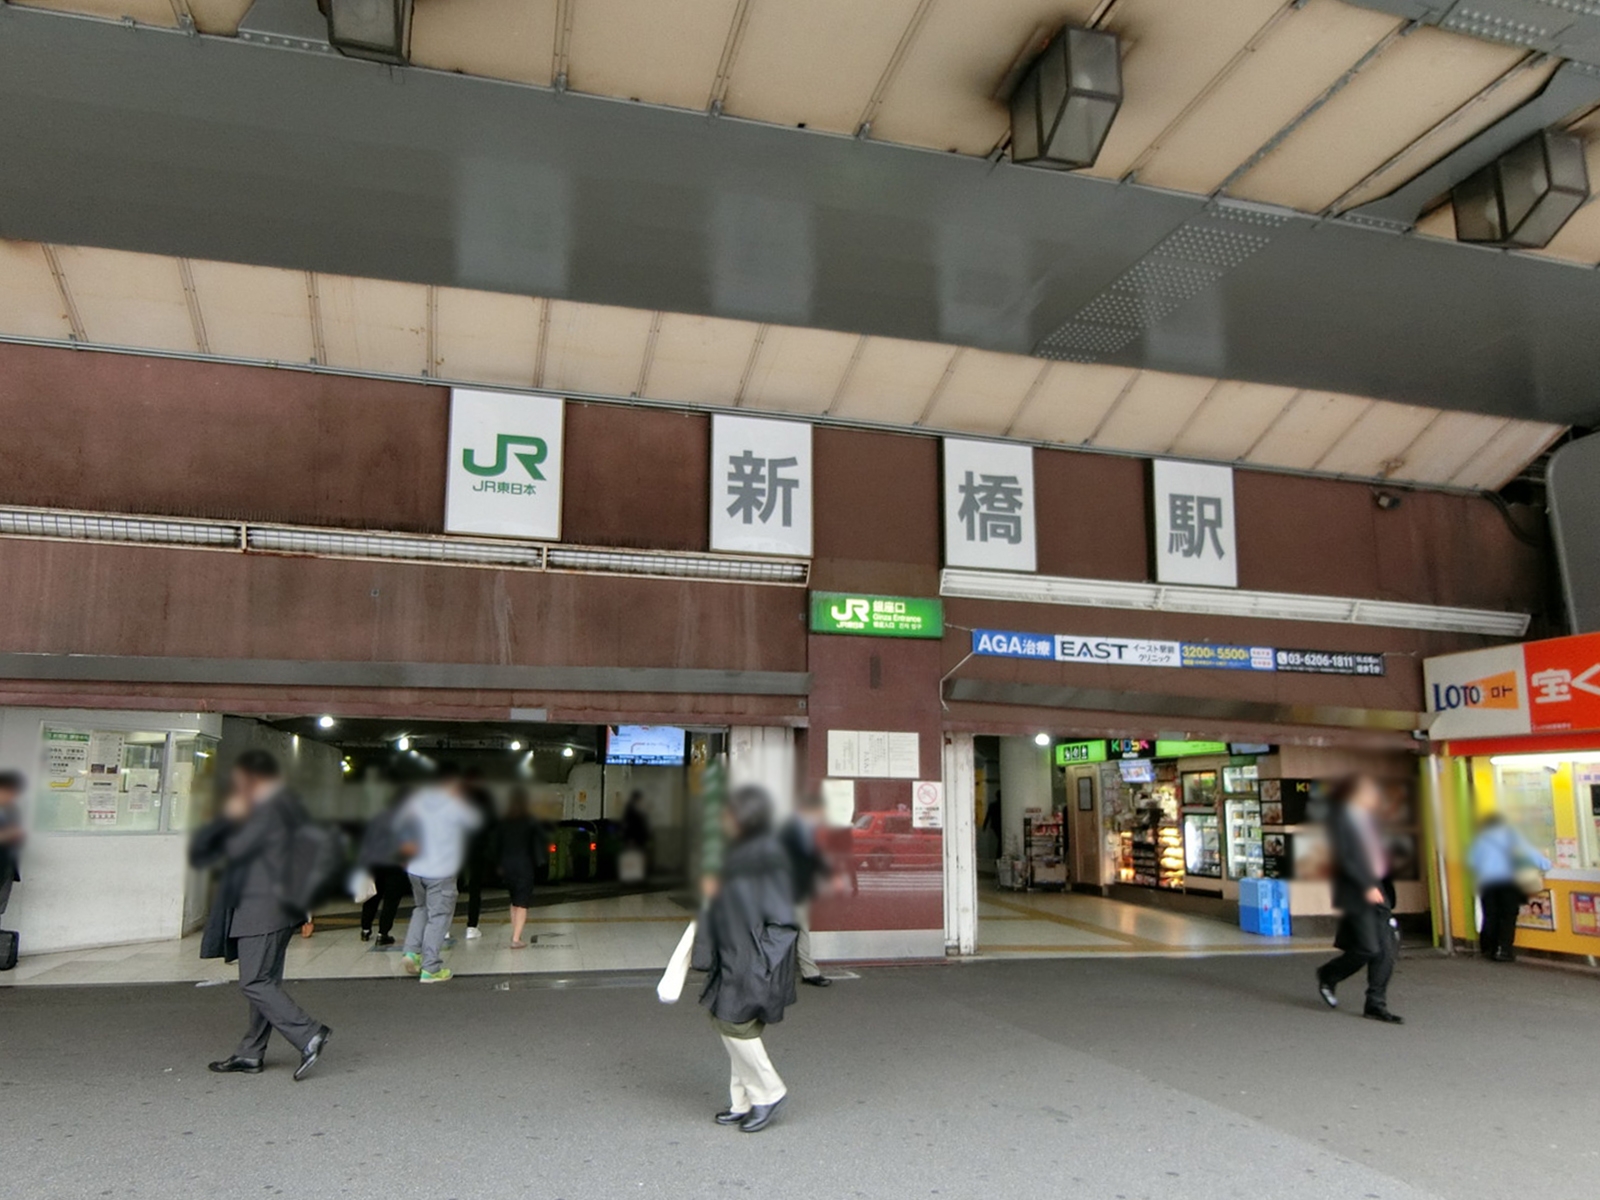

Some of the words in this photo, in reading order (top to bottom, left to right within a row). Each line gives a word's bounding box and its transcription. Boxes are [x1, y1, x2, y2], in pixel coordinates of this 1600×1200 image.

[462, 433, 548, 481] JR
[472, 480, 537, 496] JR東日本
[831, 598, 870, 622] JR
[1060, 640, 1128, 660] EAST
[1138, 654, 1171, 663] クリニック
[1288, 652, 1353, 667] 03-6206-1811
[1433, 683, 1481, 712] LOTO
